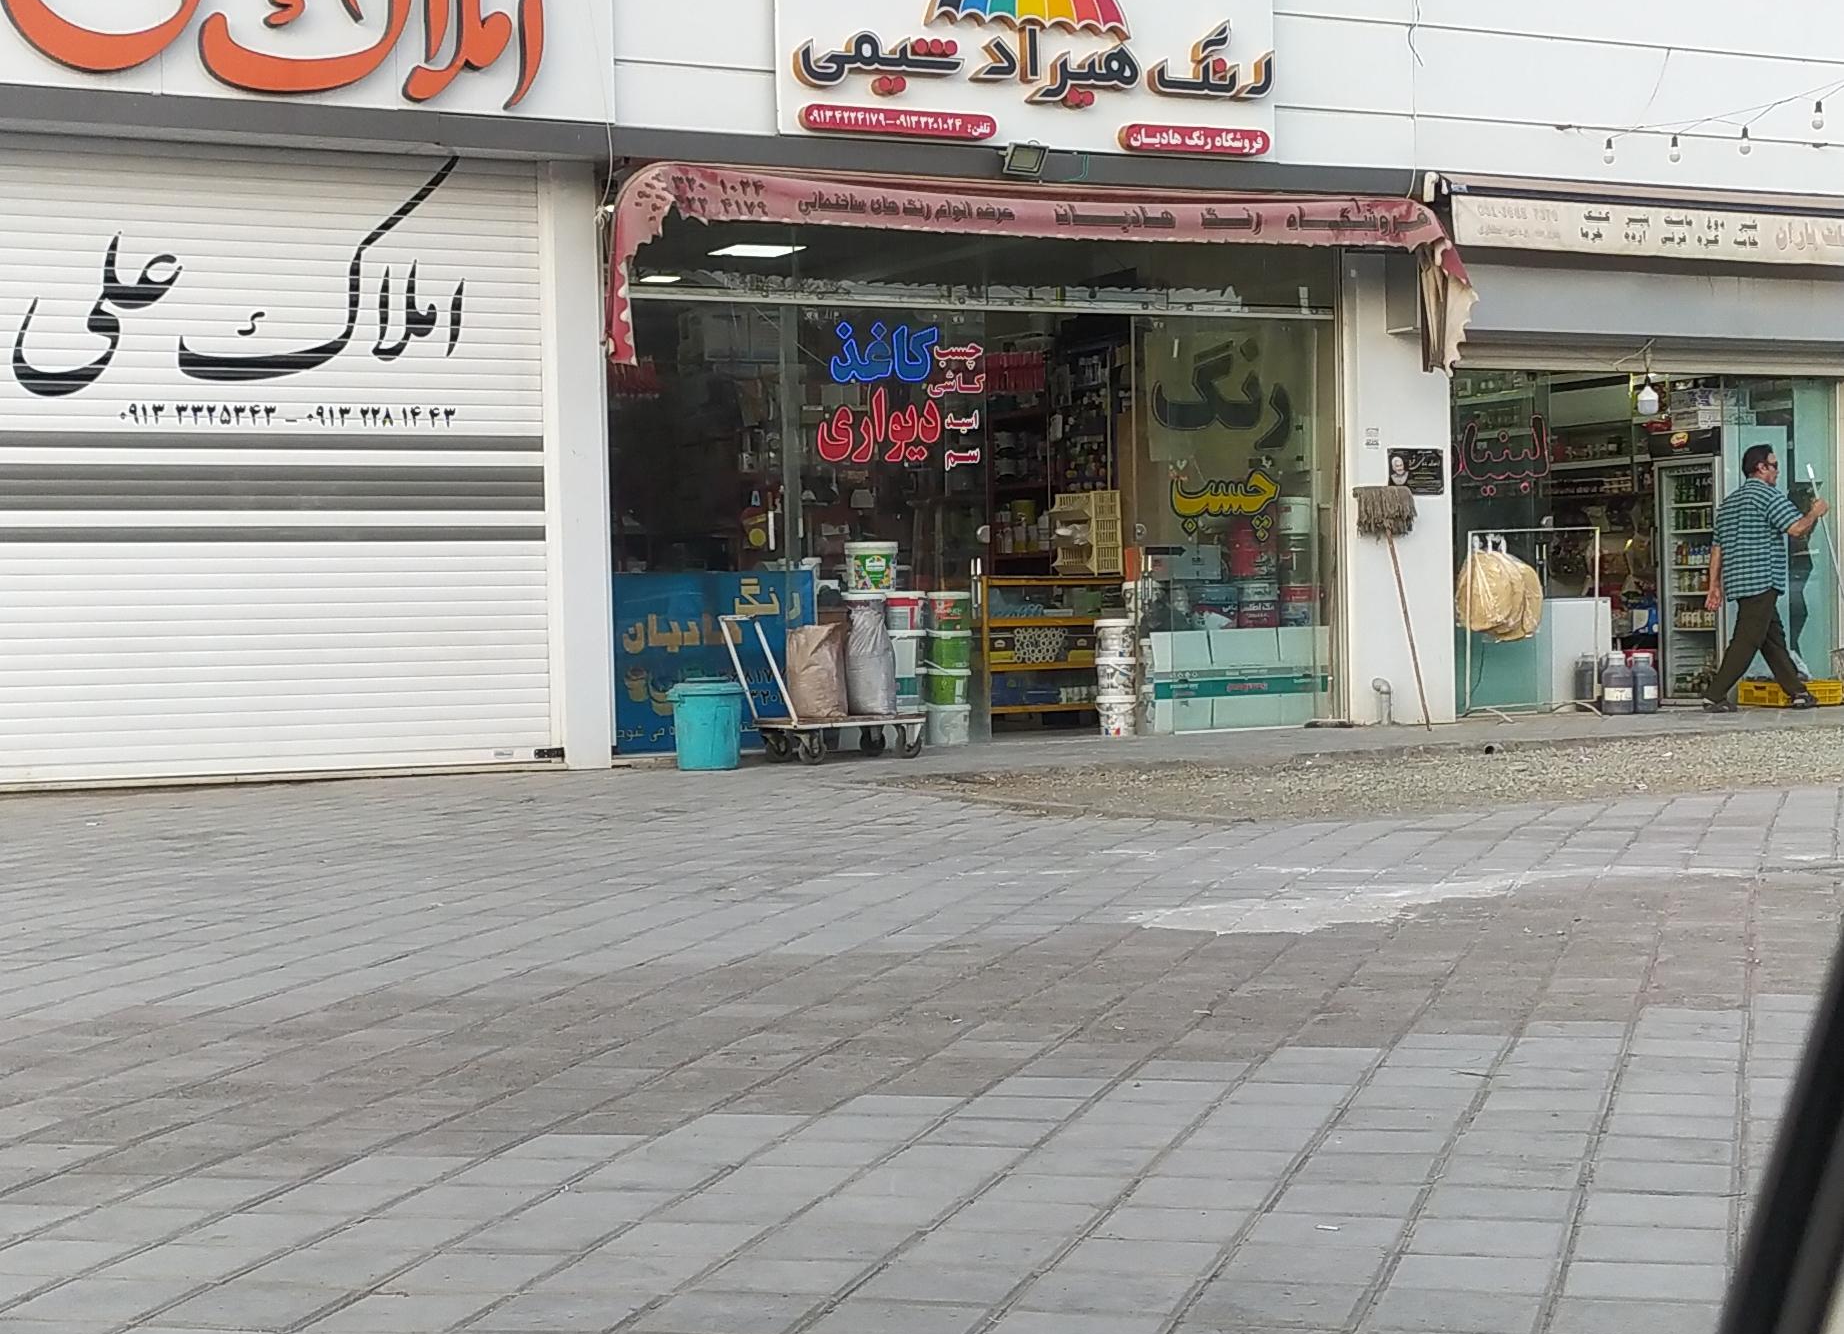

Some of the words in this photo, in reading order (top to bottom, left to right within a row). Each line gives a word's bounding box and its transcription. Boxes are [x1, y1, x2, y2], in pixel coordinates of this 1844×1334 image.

[792, 30, 965, 98] شیمی
[969, 22, 1142, 109] هیراد
[1146, 19, 1276, 98] رنگ
[1130, 128, 1183, 148] هادیان
[1185, 130, 1212, 150] رنگ
[1214, 130, 1264, 154] فروشگاه
[798, 190, 867, 216] ساختمانی
[902, 198, 932, 220] رنگ
[935, 199, 973, 222] انواع
[976, 204, 1016, 225] عرضه
[1054, 203, 1177, 233] هادیان
[1200, 206, 1263, 235] رنگ
[1286, 205, 1432, 237] فروشگاه
[1664, 214, 1693, 227] ماست
[11, 229, 184, 397] علی
[829, 320, 939, 383] کاغذ
[933, 342, 985, 371] چسب
[926, 369, 986, 398] کاشی
[1152, 338, 1291, 451] رنگ
[119, 403, 165, 426] ۰۹۱۳
[306, 405, 352, 428] ۰۹۱۳
[816, 385, 942, 464] دیواری
[944, 409, 980, 434] اسید
[944, 446, 981, 472] سم
[1169, 467, 1281, 542] چسب
[734, 577, 801, 621] رنگ
[622, 613, 743, 655] هادیان
